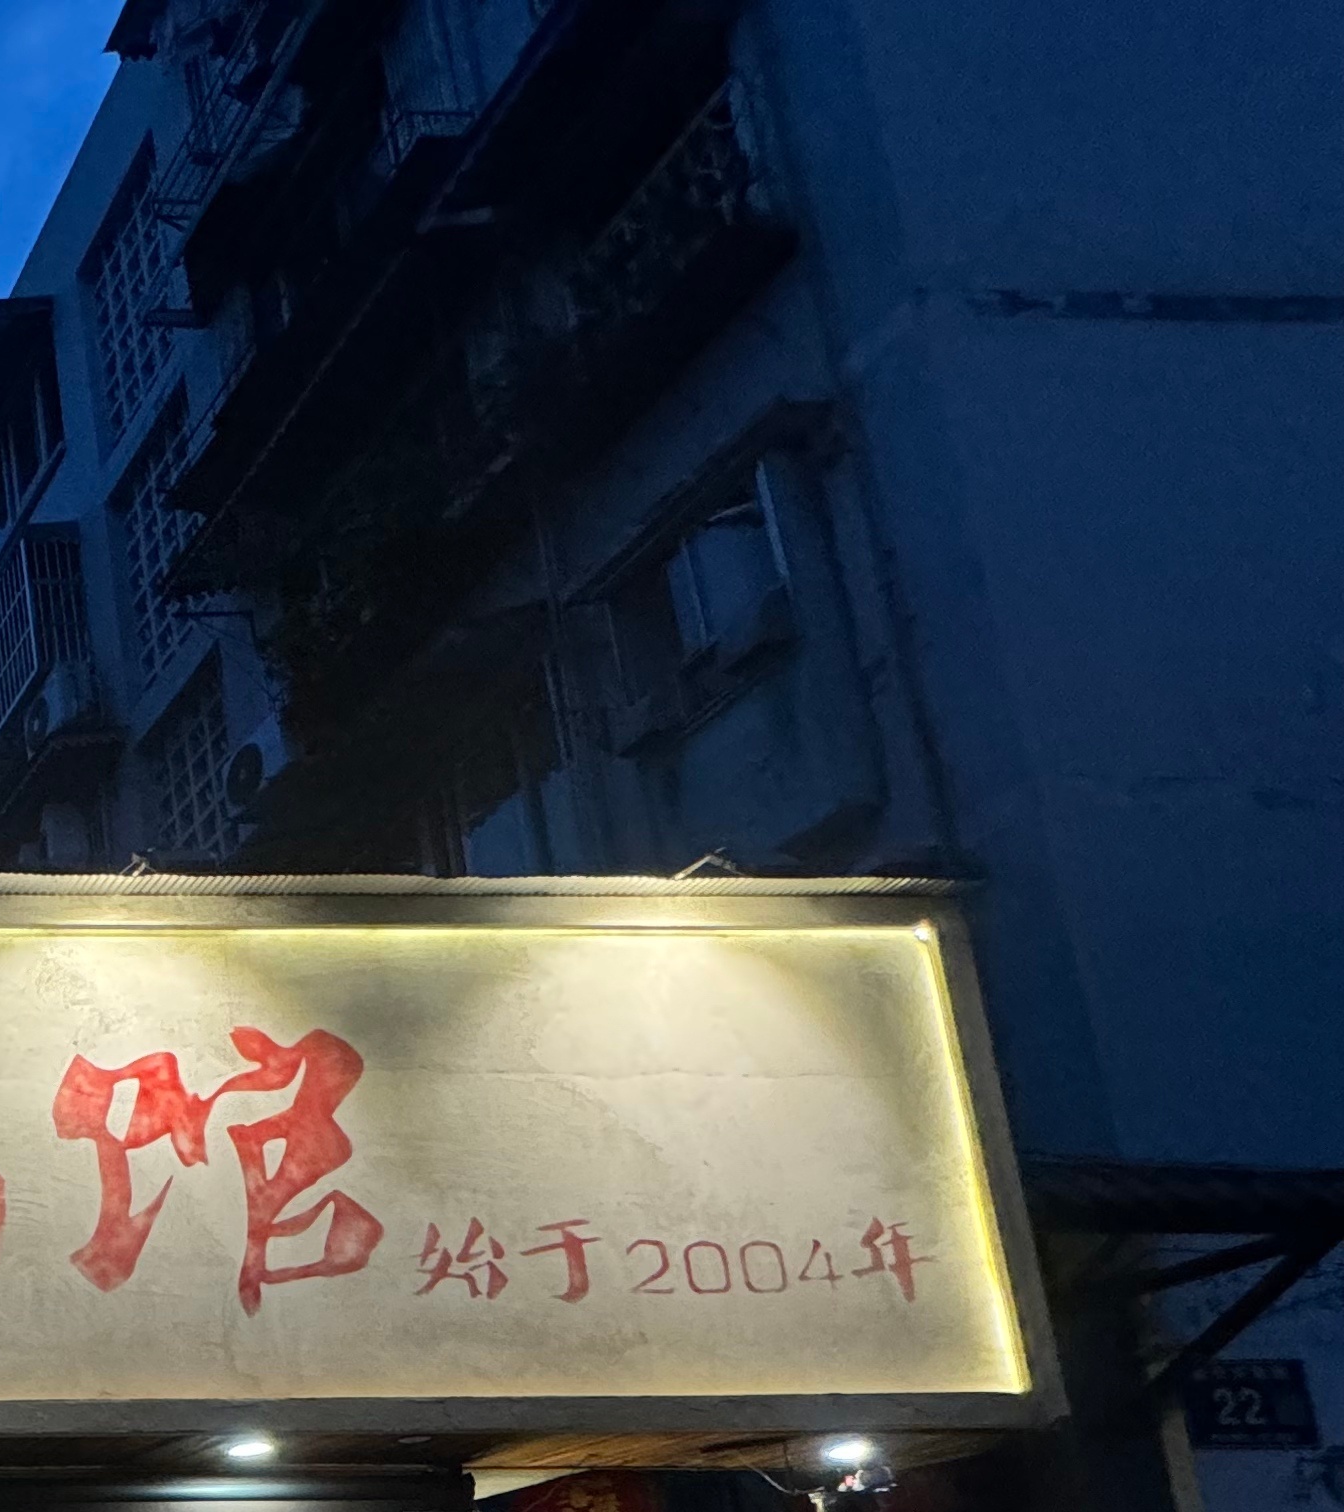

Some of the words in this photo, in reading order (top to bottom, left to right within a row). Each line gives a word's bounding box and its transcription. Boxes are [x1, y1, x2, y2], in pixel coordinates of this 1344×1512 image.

[413, 1216, 940, 1303] 始于2004年
[1212, 1386, 1269, 1427] 22
